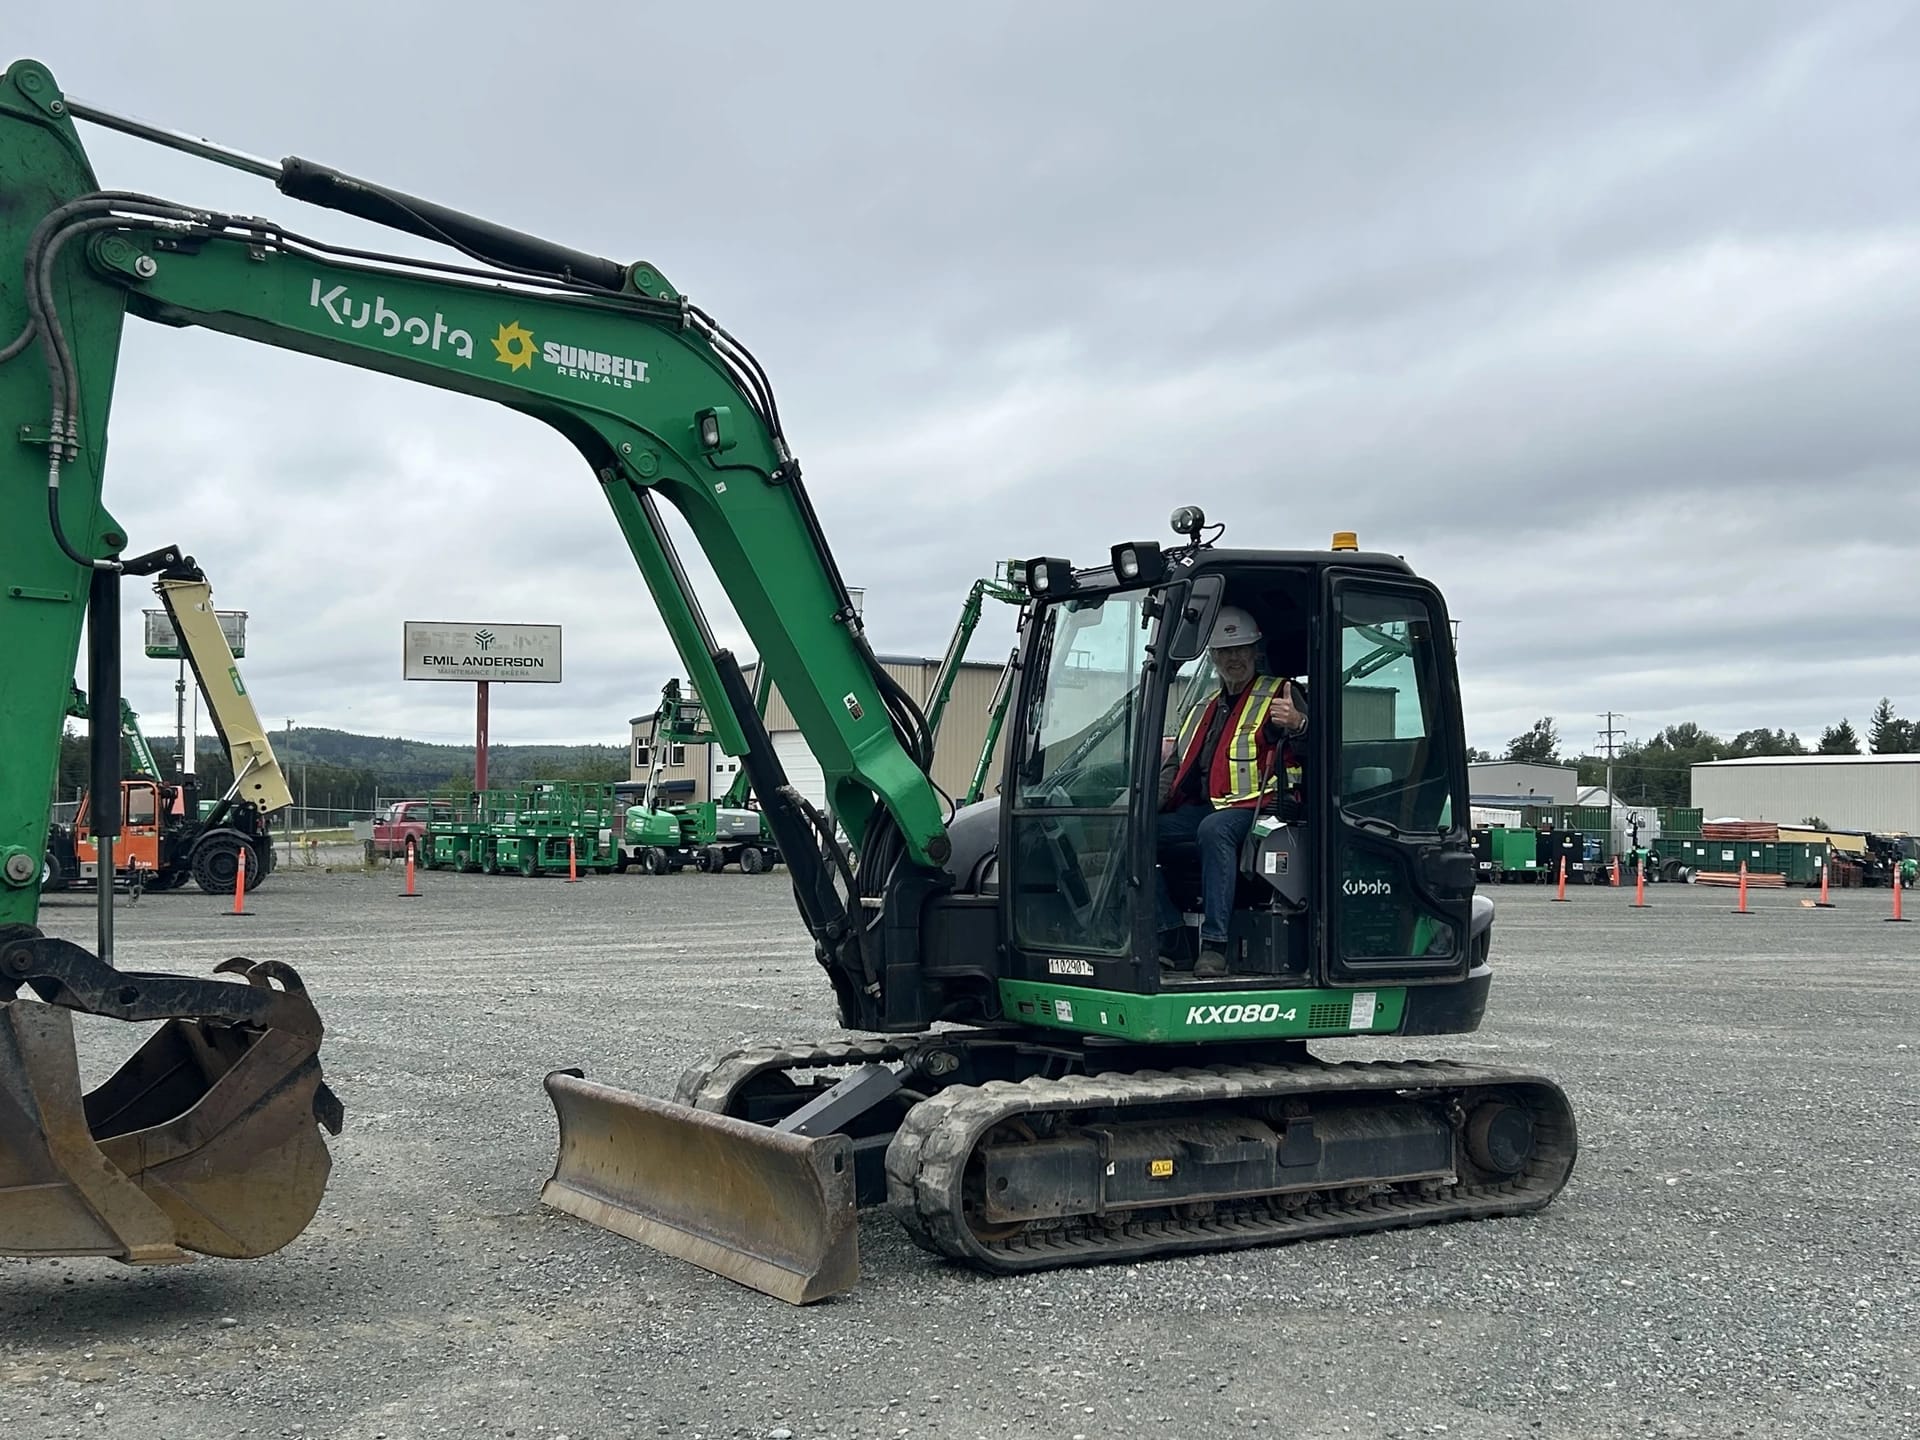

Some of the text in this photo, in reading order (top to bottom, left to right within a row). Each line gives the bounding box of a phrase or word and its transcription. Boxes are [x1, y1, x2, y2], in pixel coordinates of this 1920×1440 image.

[310, 278, 474, 360] Kubota
[543, 341, 649, 383] SUNBELT
[557, 366, 632, 389] RENTALS
[423, 655, 544, 668] EMIL ANDERSON
[1342, 879, 1391, 895] Kubota
[1185, 1003, 1297, 1025] KX080-4
